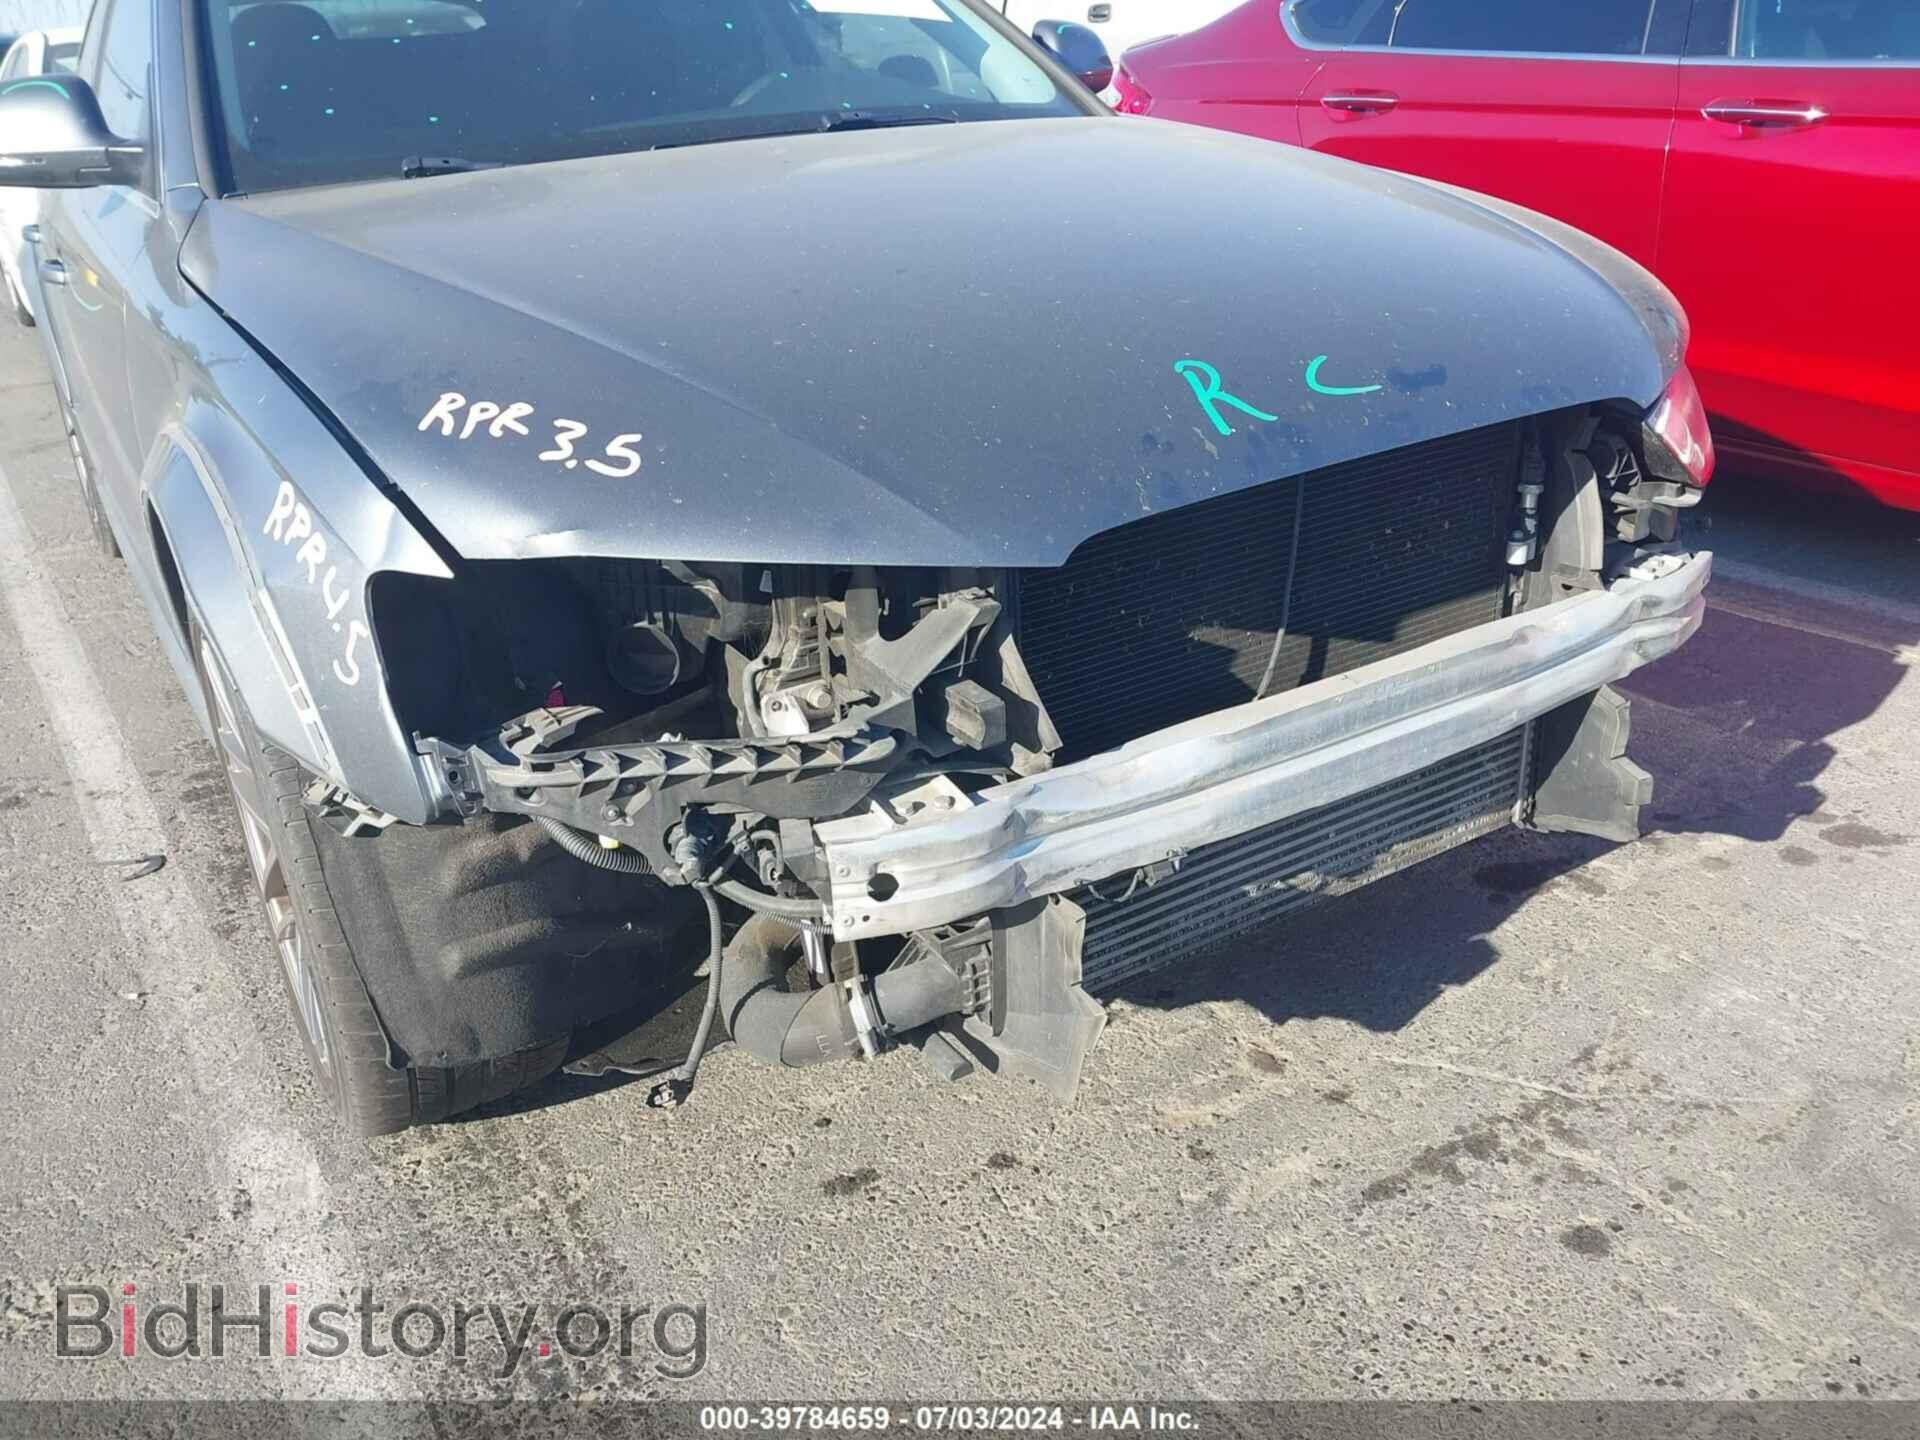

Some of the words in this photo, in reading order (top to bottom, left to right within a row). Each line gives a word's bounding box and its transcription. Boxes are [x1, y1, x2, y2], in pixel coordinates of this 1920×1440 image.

[418, 392, 535, 440] RPR
[538, 418, 643, 478] 3.5
[1174, 359, 1279, 436] R
[263, 481, 328, 585] RPR
